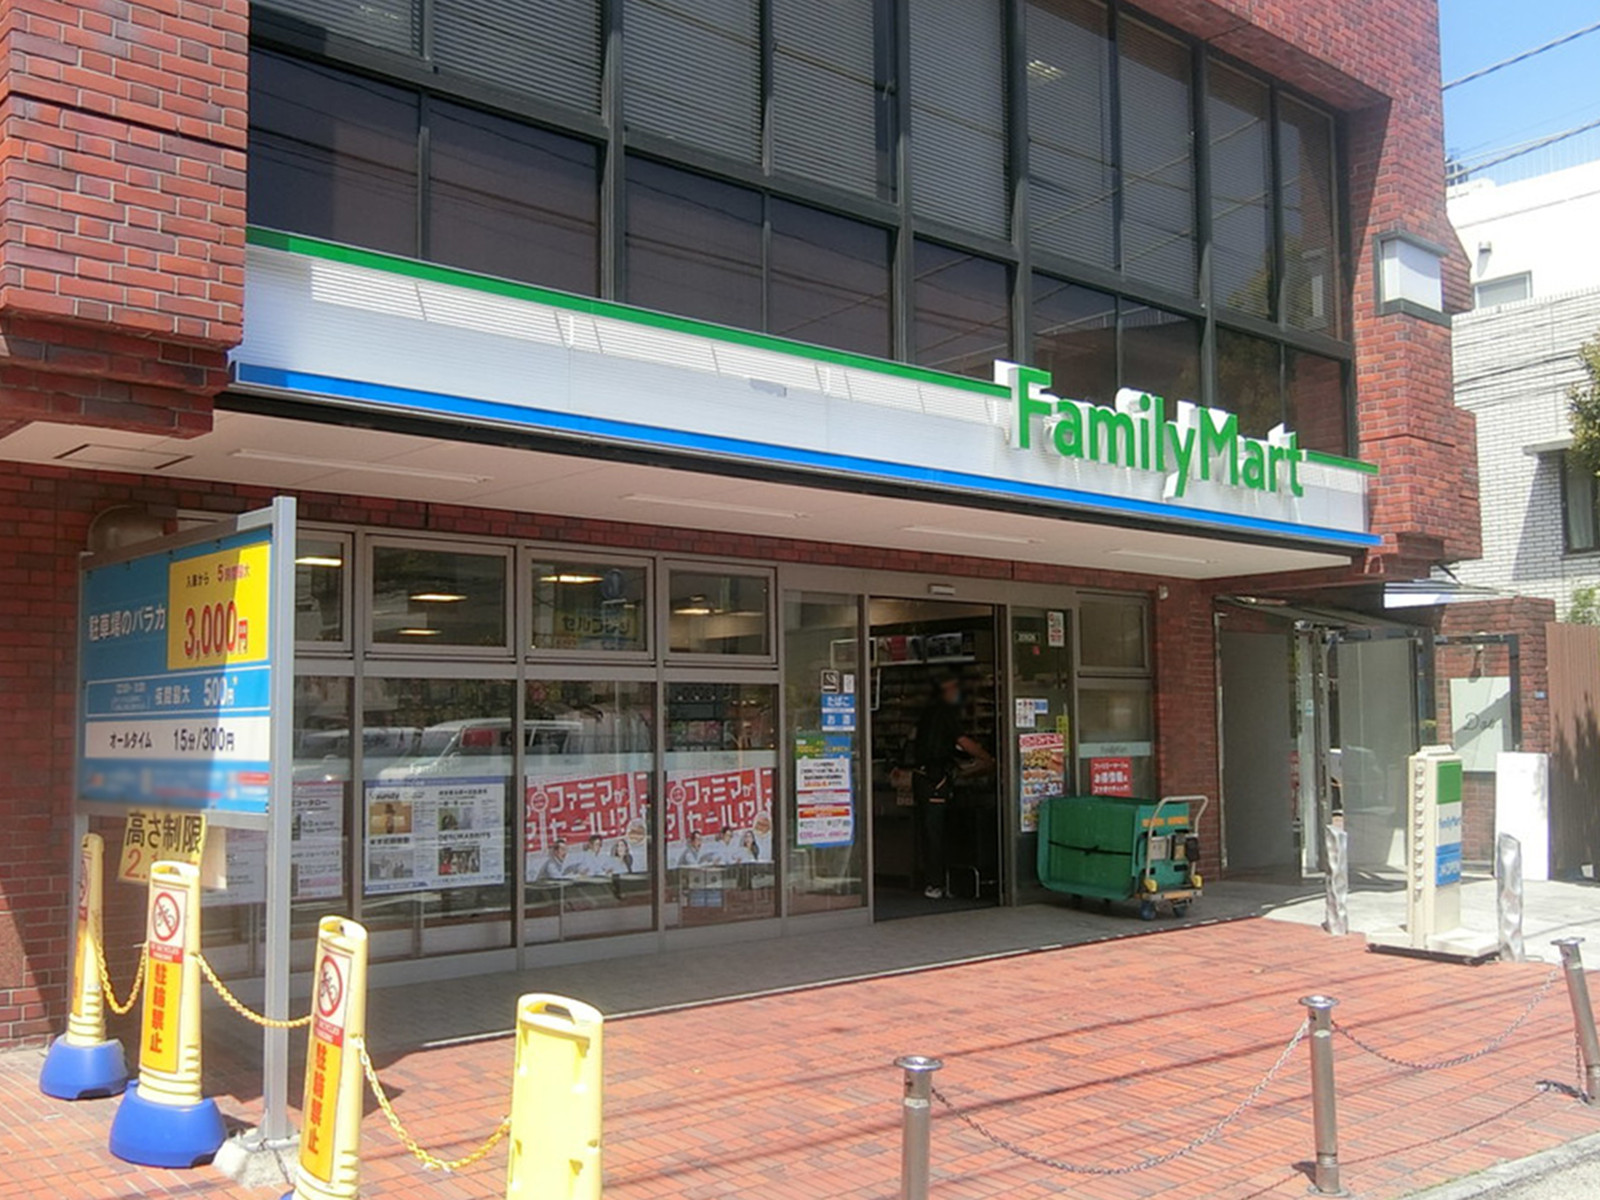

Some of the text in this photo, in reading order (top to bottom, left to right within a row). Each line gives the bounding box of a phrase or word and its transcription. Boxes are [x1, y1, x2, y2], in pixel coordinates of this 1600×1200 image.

[1011, 364, 1304, 498] FamilyMart
[184, 600, 248, 661] 3,000円
[203, 676, 235, 707] 500円
[109, 726, 235, 752] オールタイム 15分/300円
[546, 779, 629, 814] ファミマが
[684, 775, 755, 807] ファミマが
[125, 812, 202, 854] 高さ制限
[150, 963, 168, 1054] 駐輪禁止
